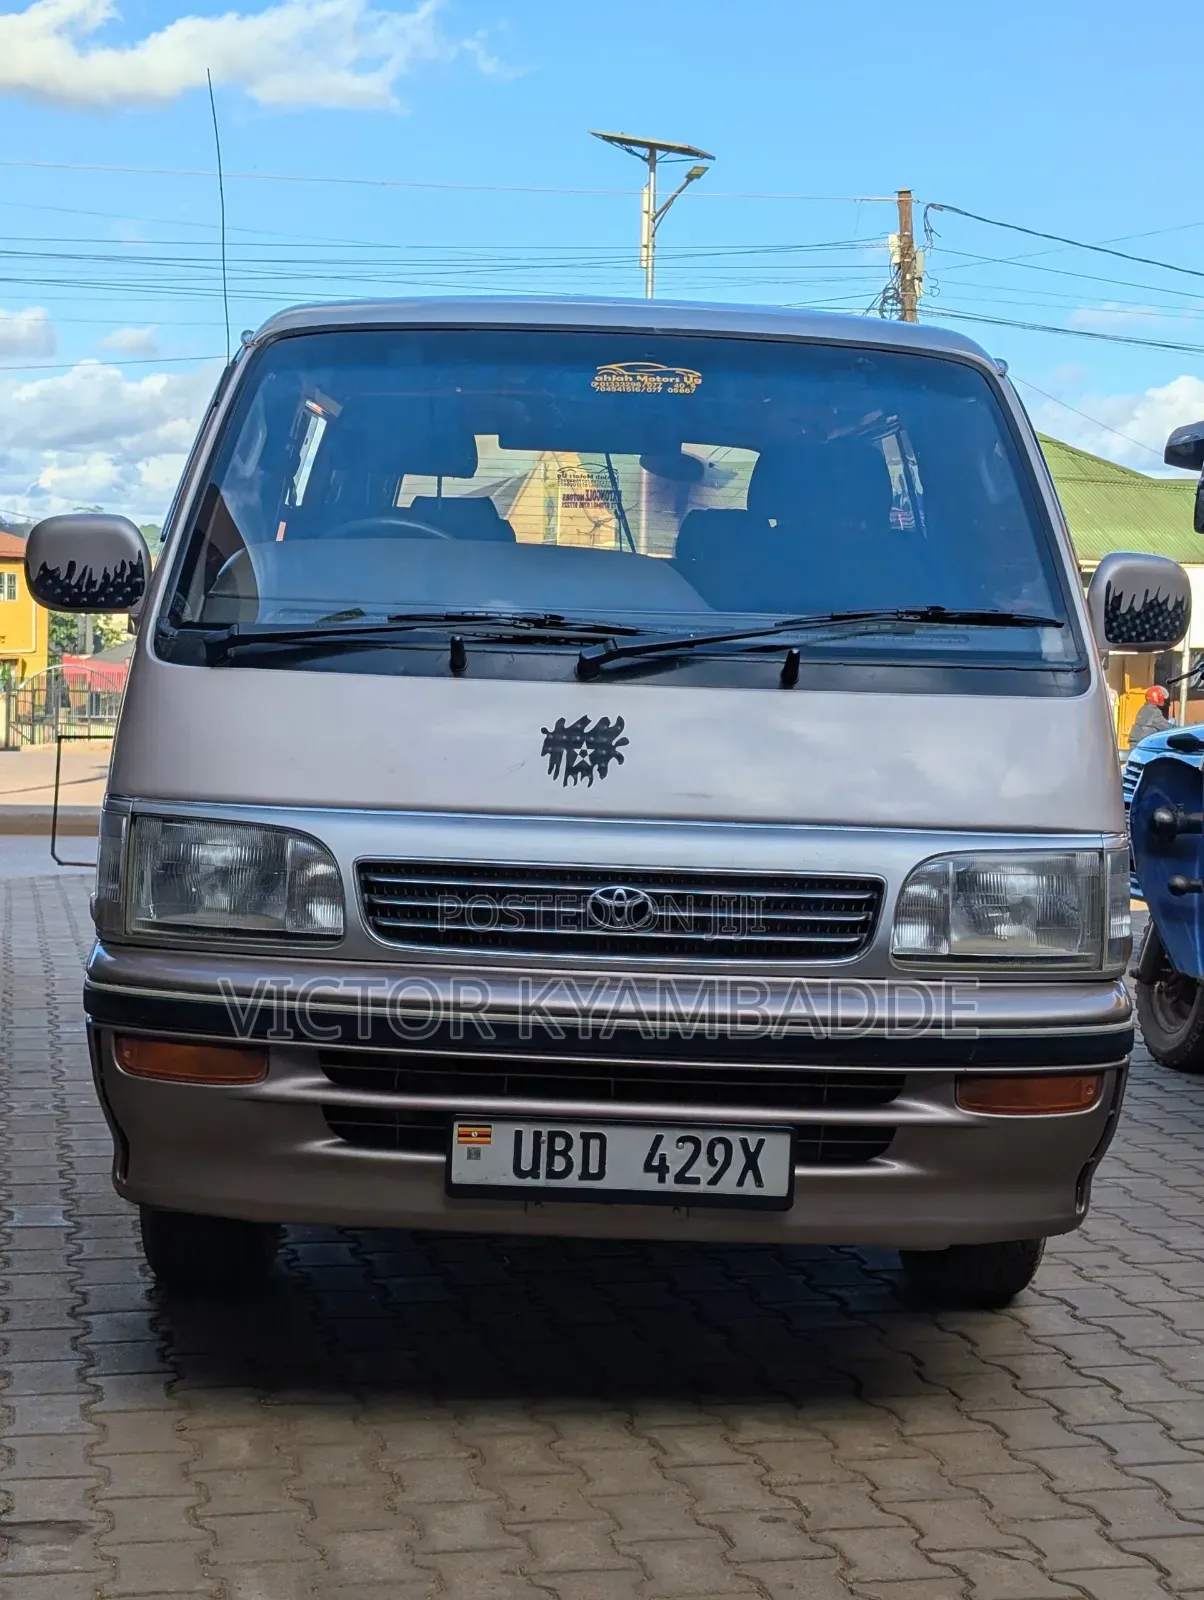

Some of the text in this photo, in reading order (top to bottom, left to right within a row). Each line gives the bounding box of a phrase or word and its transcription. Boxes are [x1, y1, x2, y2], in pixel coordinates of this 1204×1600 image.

[636, 375, 680, 383] Motors
[512, 1129, 766, 1187] UBD 429X
